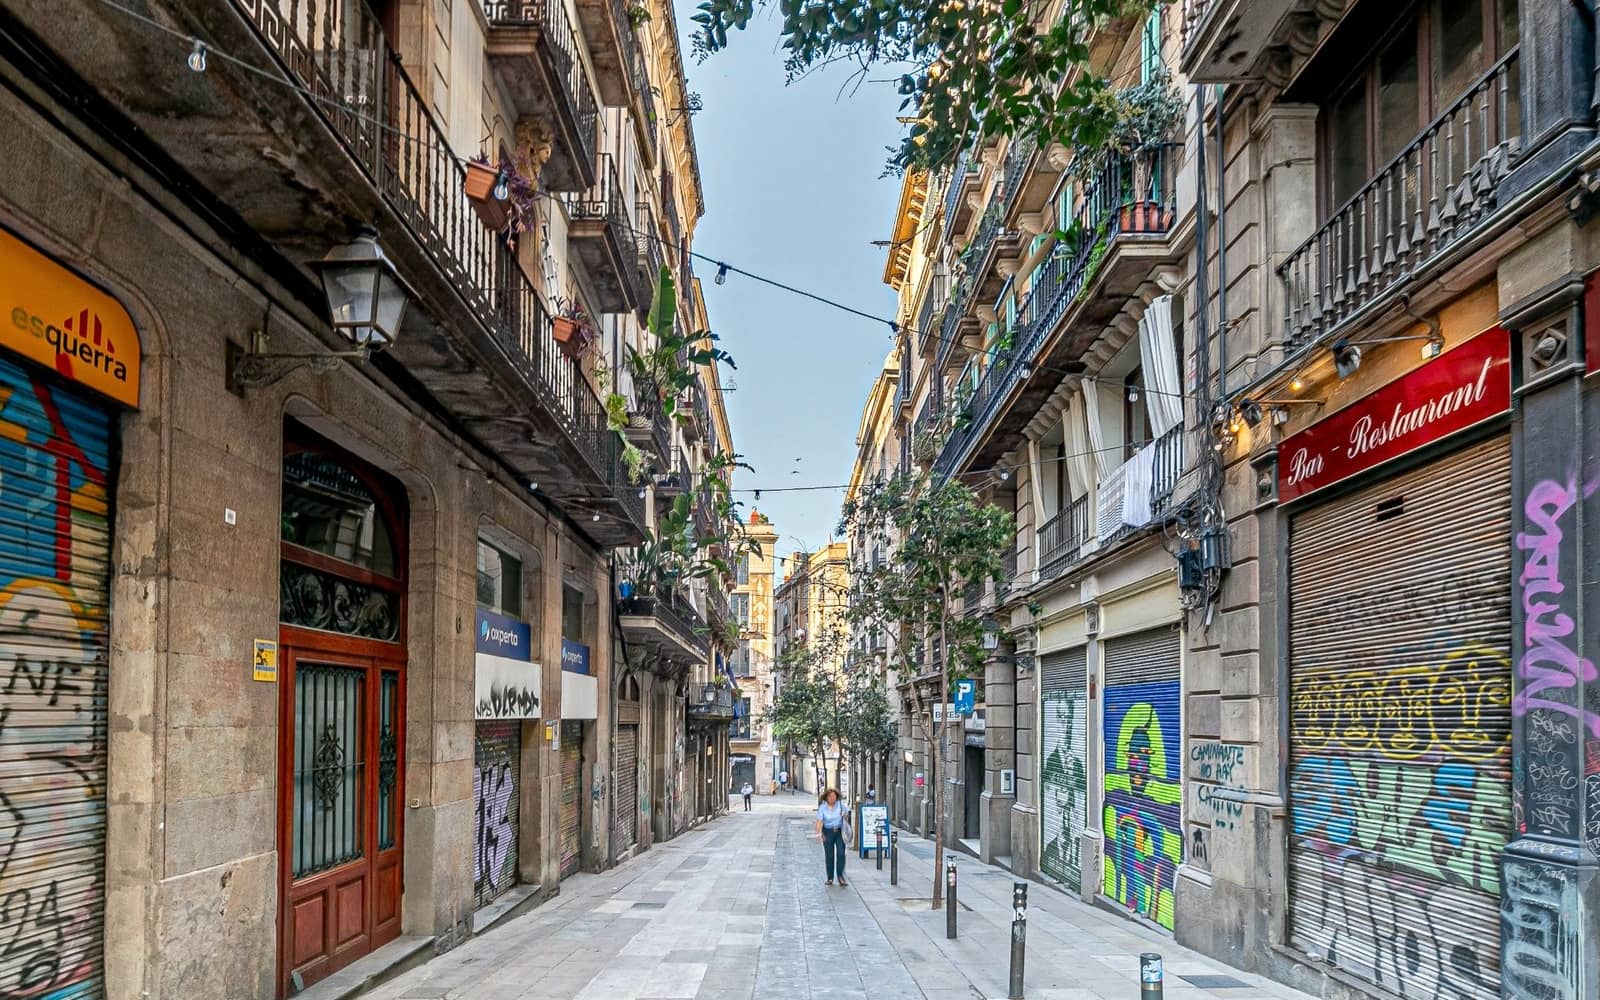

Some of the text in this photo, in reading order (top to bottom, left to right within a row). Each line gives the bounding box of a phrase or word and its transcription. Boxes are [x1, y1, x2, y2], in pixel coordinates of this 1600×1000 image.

[11, 306, 128, 382] esquerra
[1287, 448, 1324, 486] Bar
[1347, 356, 1493, 460] Restaurant
[490, 626, 518, 648] axperta
[567, 651, 583, 665] axperta
[958, 682, 972, 701] P
[1200, 762, 1212, 779] NO
